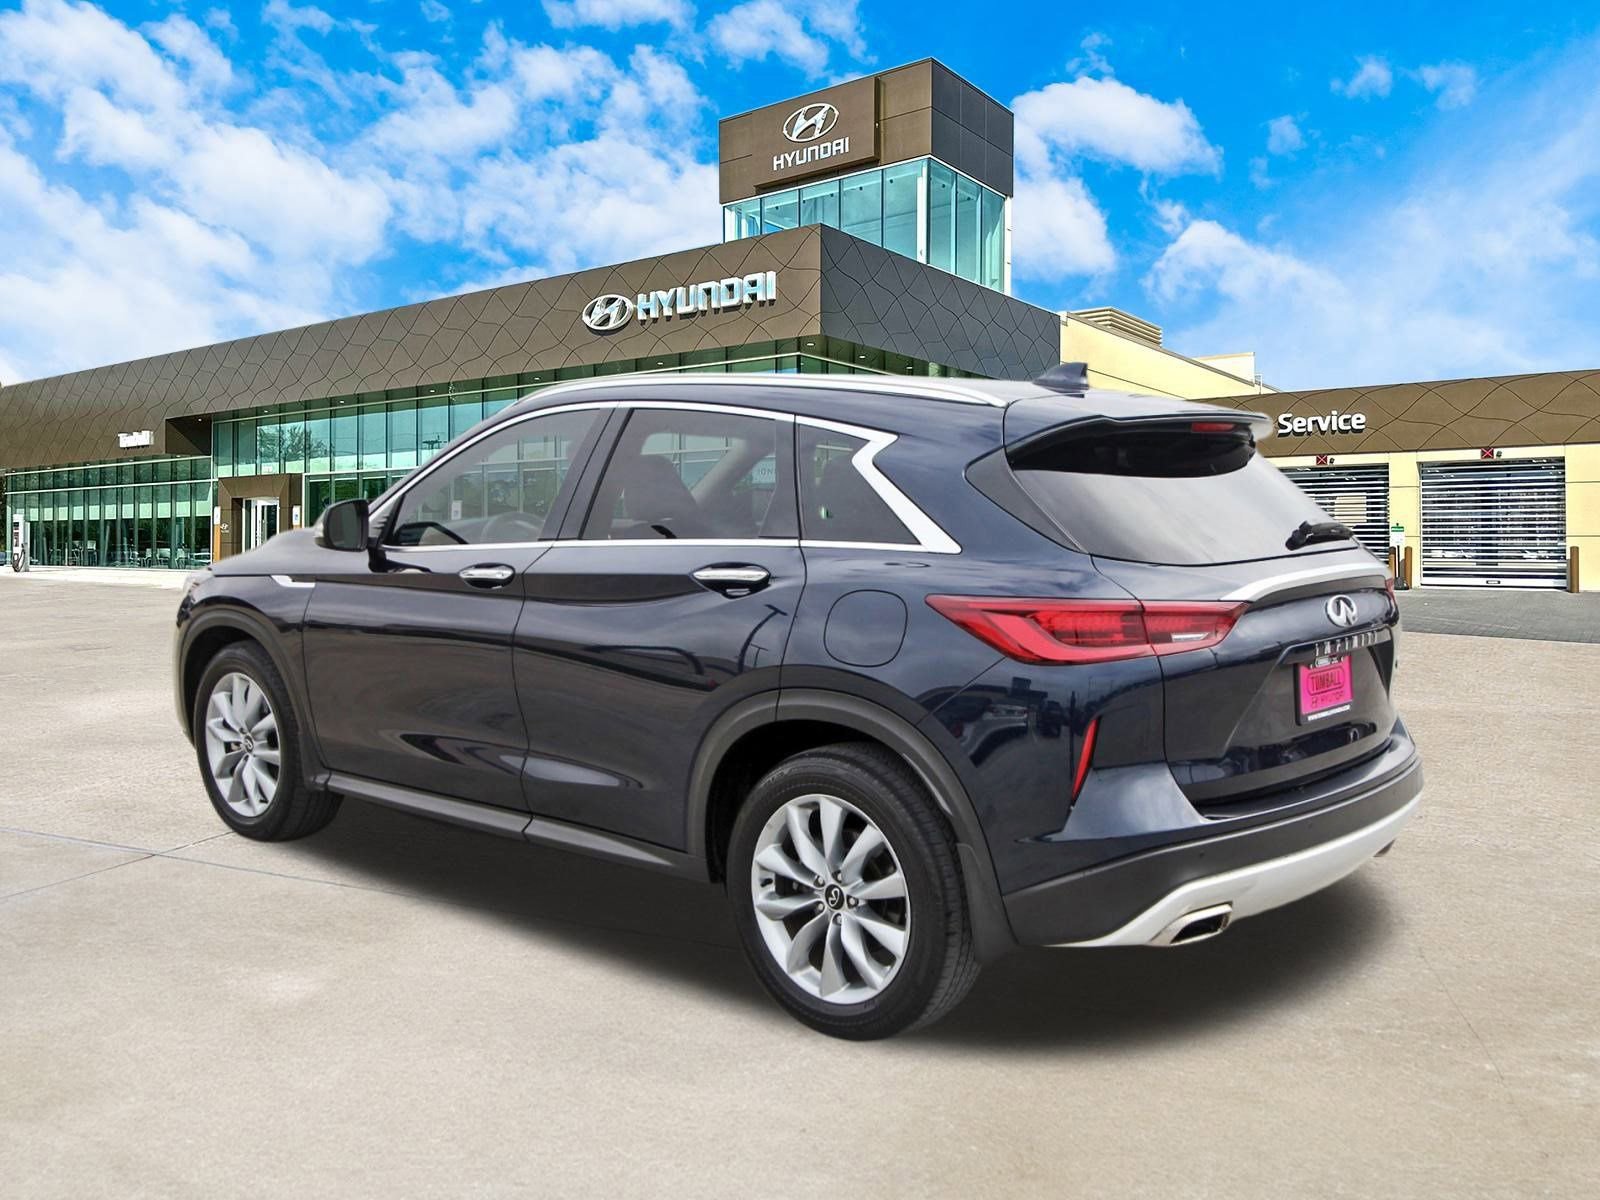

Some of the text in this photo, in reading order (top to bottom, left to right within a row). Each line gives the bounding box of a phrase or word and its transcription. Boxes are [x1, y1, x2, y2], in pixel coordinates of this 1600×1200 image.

[773, 136, 850, 171] HYUNDAI
[637, 270, 777, 321] HYUNDAI
[1278, 410, 1366, 433] Service
